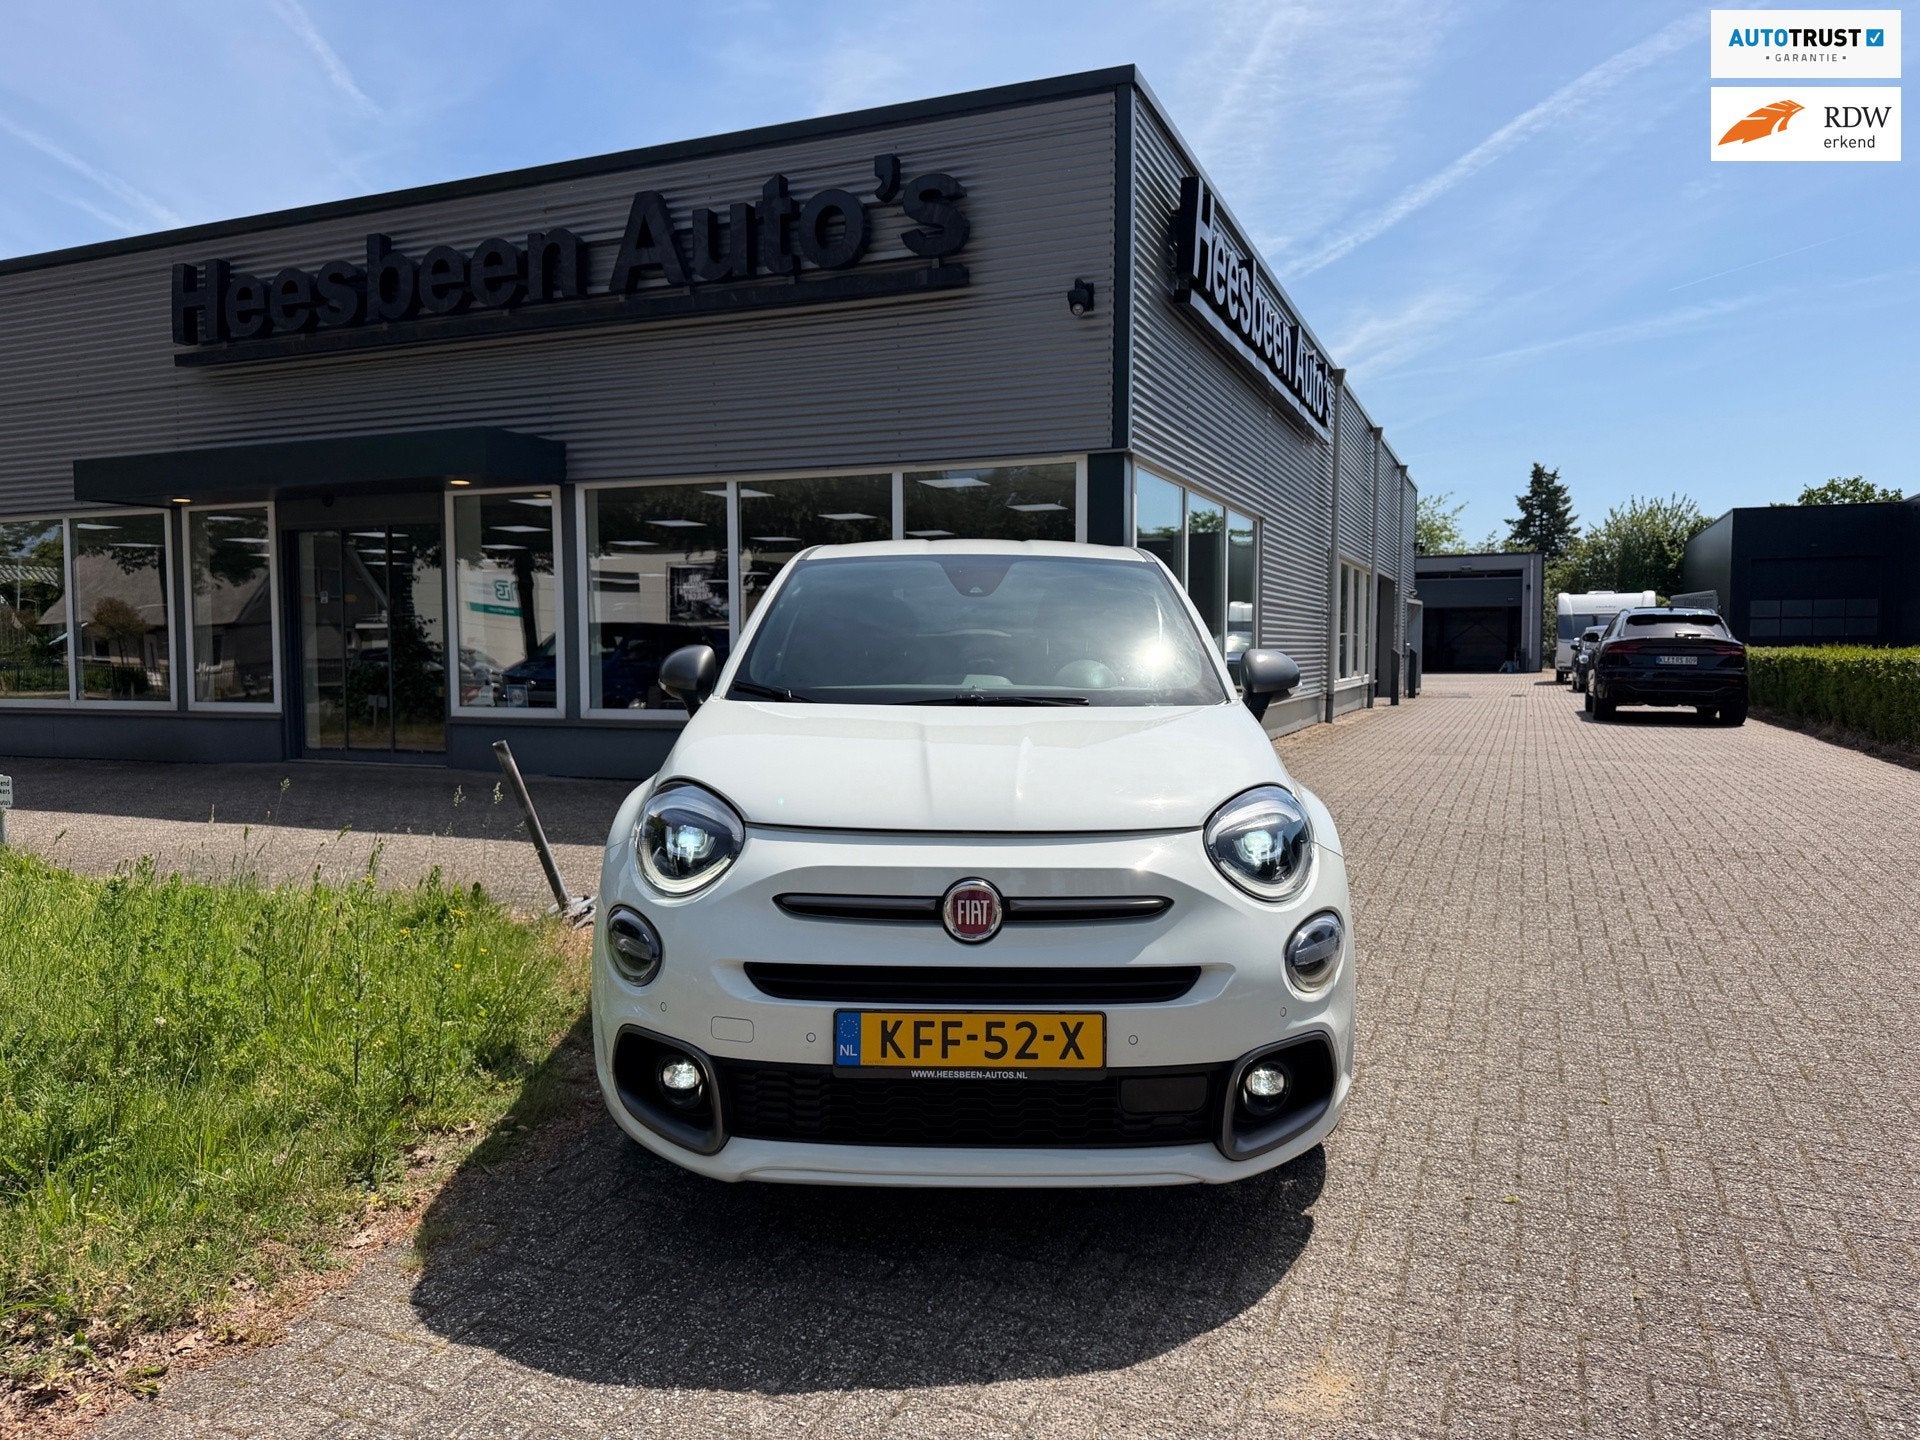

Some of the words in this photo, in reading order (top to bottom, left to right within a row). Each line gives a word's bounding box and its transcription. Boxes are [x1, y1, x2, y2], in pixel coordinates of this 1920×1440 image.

[171, 231, 589, 347] Heesbeen
[608, 153, 972, 297] Auto's
[1188, 176, 1293, 382] Heesbeen
[1294, 325, 1333, 428] Auto's
[957, 899, 990, 926] FIAT
[839, 1044, 858, 1057] NL
[879, 1019, 1085, 1061] KFF-52-X
[910, 1069, 1029, 1080] WWW.HEESBEEN-AUTOS.NL
